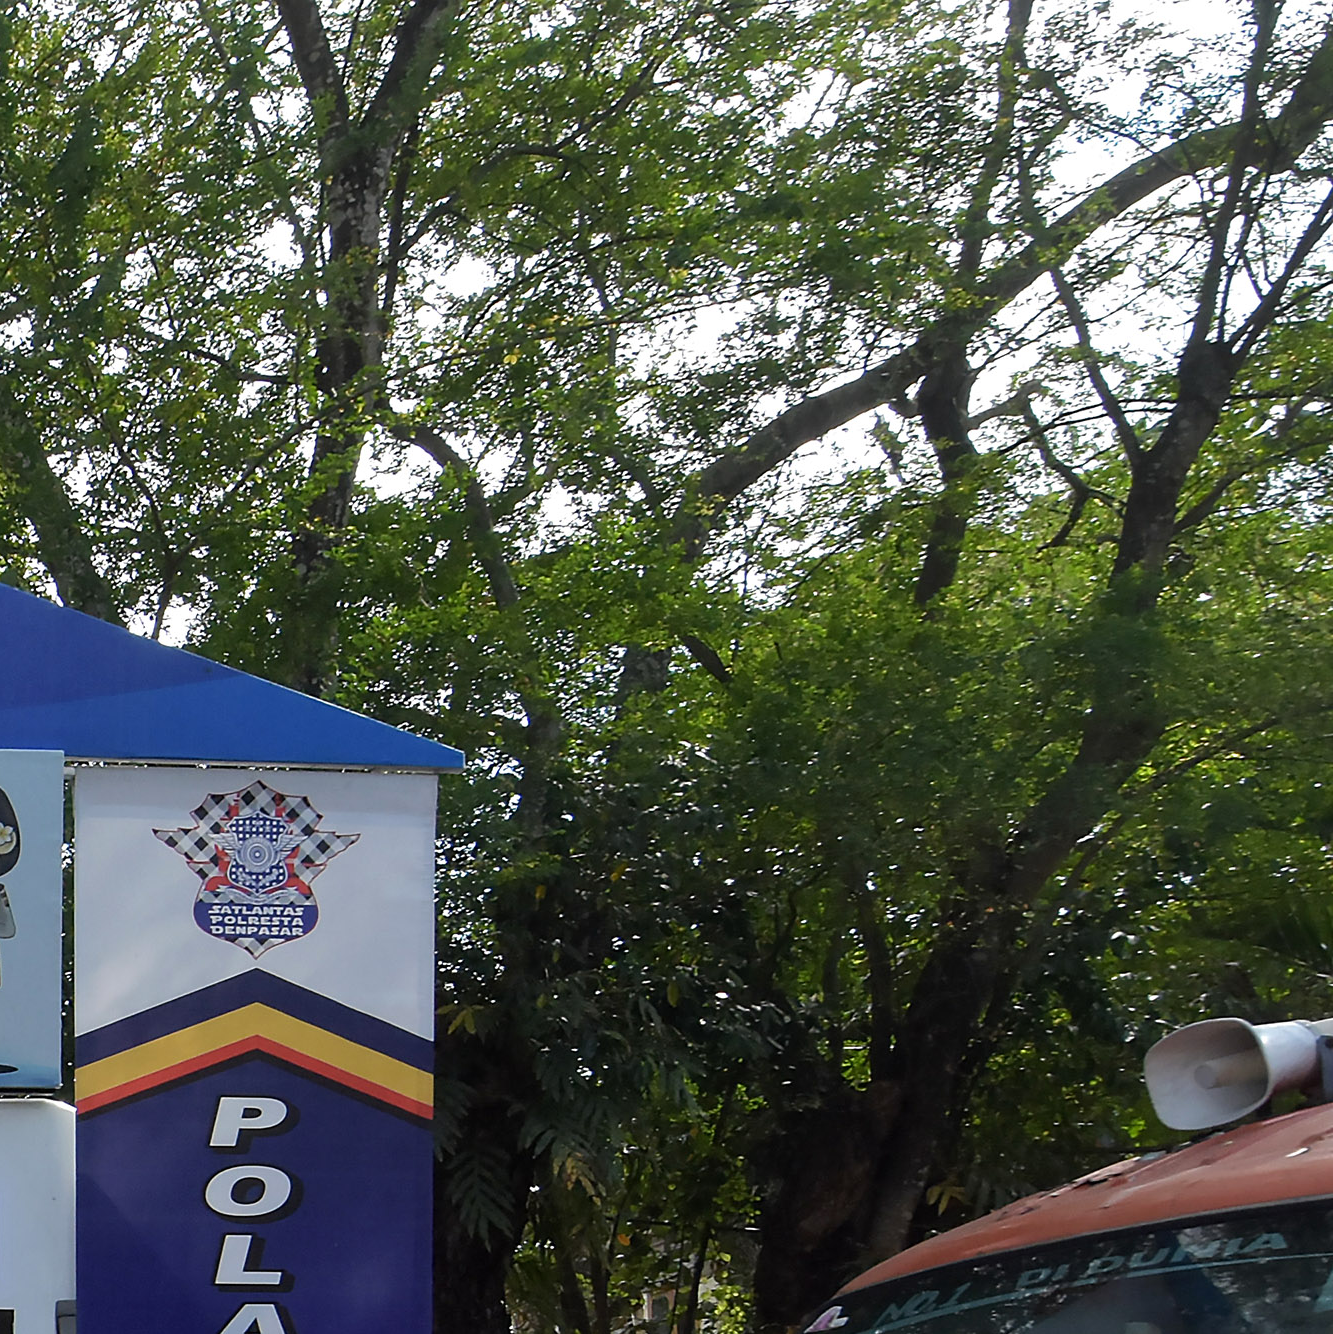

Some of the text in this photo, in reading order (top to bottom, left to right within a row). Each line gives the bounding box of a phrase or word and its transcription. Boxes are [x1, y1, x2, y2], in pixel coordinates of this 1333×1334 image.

[208, 905, 304, 916] SATLANTAS
[210, 915, 304, 926] POLRESTA
[210, 925, 304, 936] DENPASAR
[1016, 1264, 1070, 1291] DI
